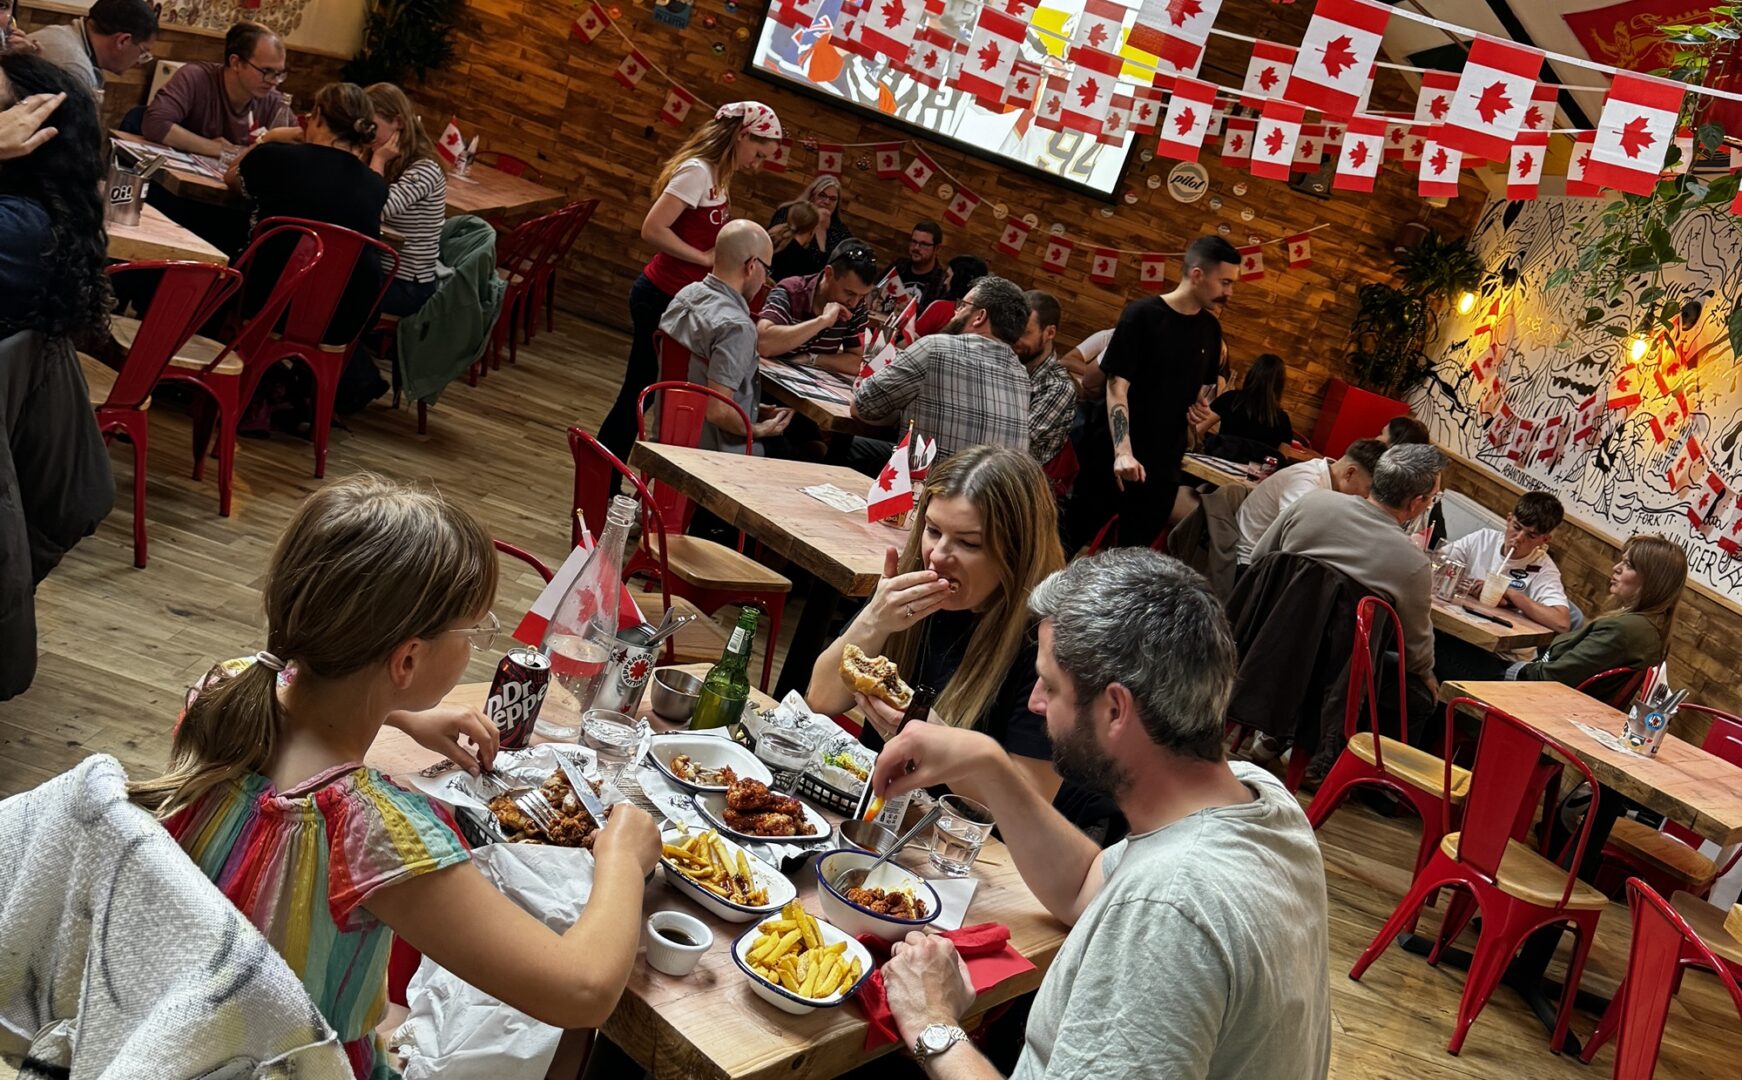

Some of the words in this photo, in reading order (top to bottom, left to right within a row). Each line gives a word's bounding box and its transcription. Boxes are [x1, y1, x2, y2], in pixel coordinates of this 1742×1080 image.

[1170, 175, 1205, 190] pilot
[1648, 451, 1675, 474] HATC
[1635, 512, 1661, 526] FORK
[502, 680, 532, 708] Dr
[487, 683, 548, 730] Peppe
